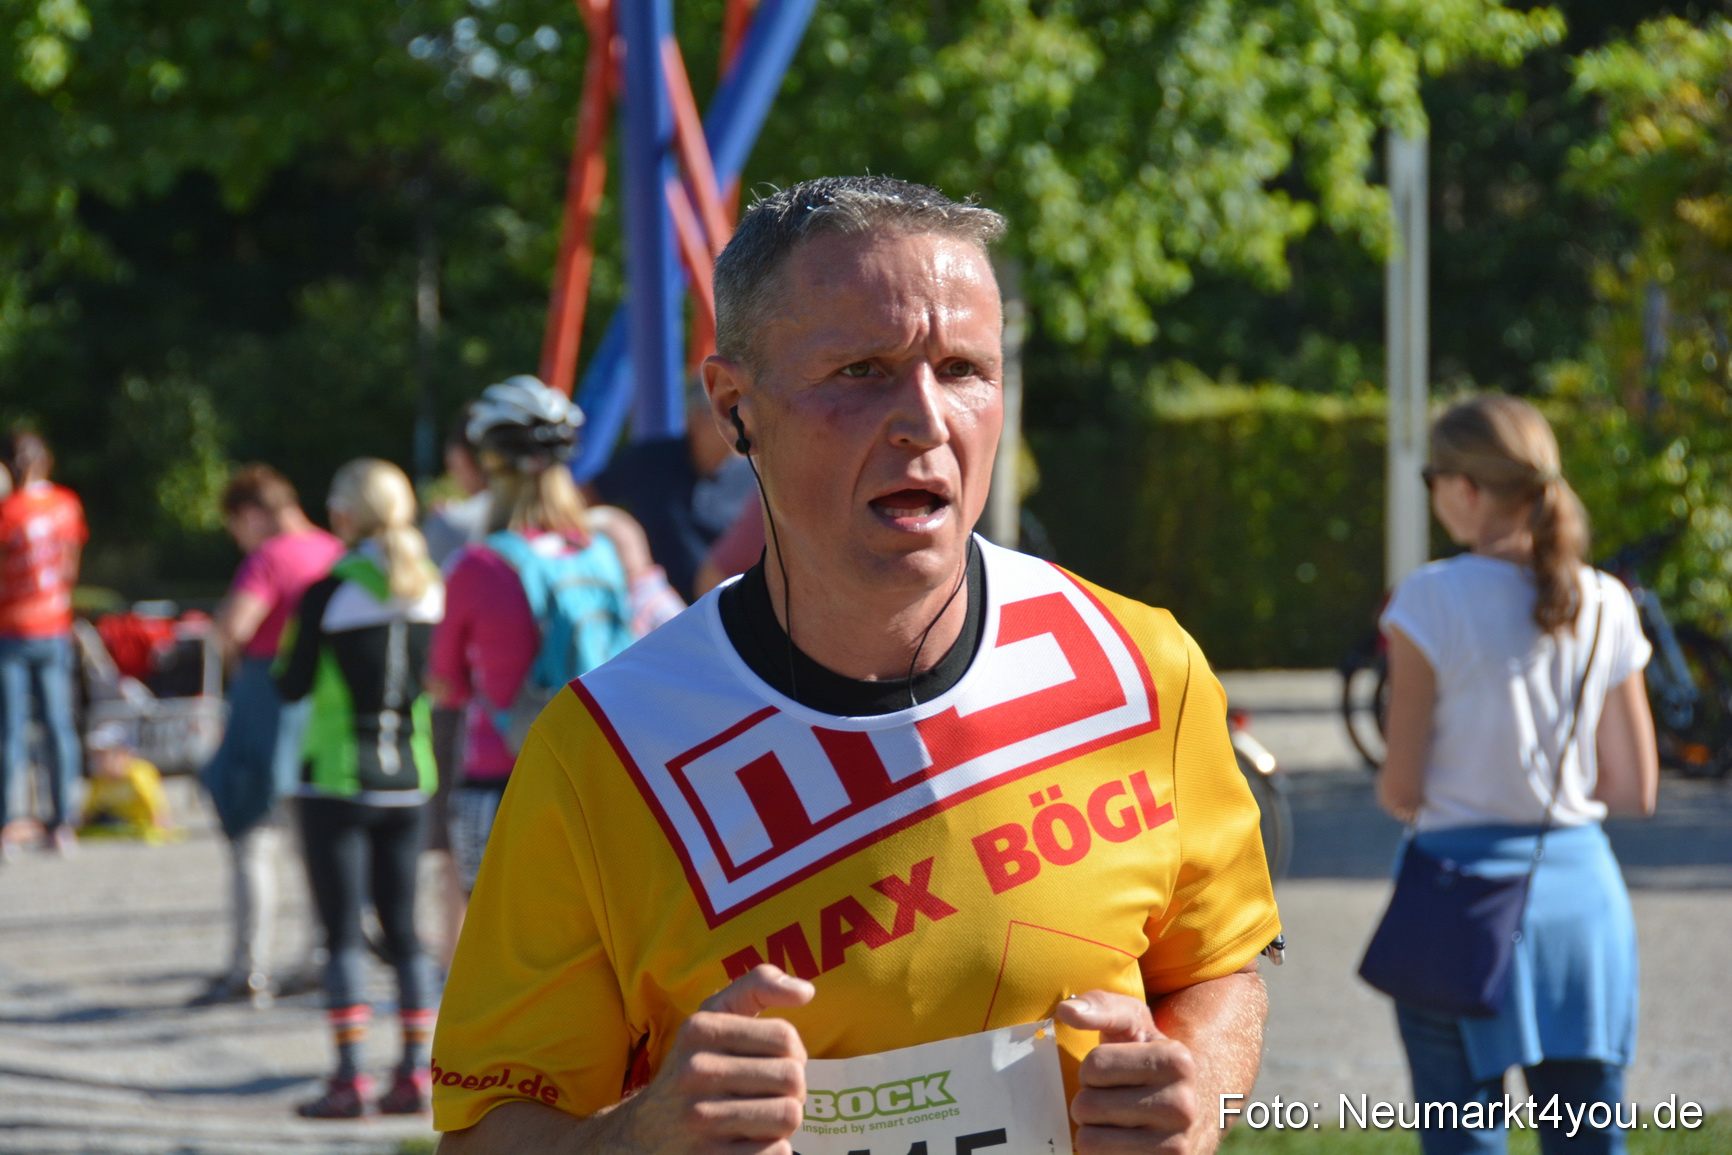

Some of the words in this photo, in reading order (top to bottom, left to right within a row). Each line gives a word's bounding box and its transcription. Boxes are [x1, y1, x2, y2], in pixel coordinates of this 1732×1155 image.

[721, 856, 959, 982] MAX
[971, 770, 1174, 895] BÖGL
[802, 1122, 848, 1135] inspired
[851, 1124, 865, 1134] by
[869, 1117, 904, 1130] smart
[907, 1108, 960, 1125] concepts
[804, 1070, 957, 1122] BOCK
